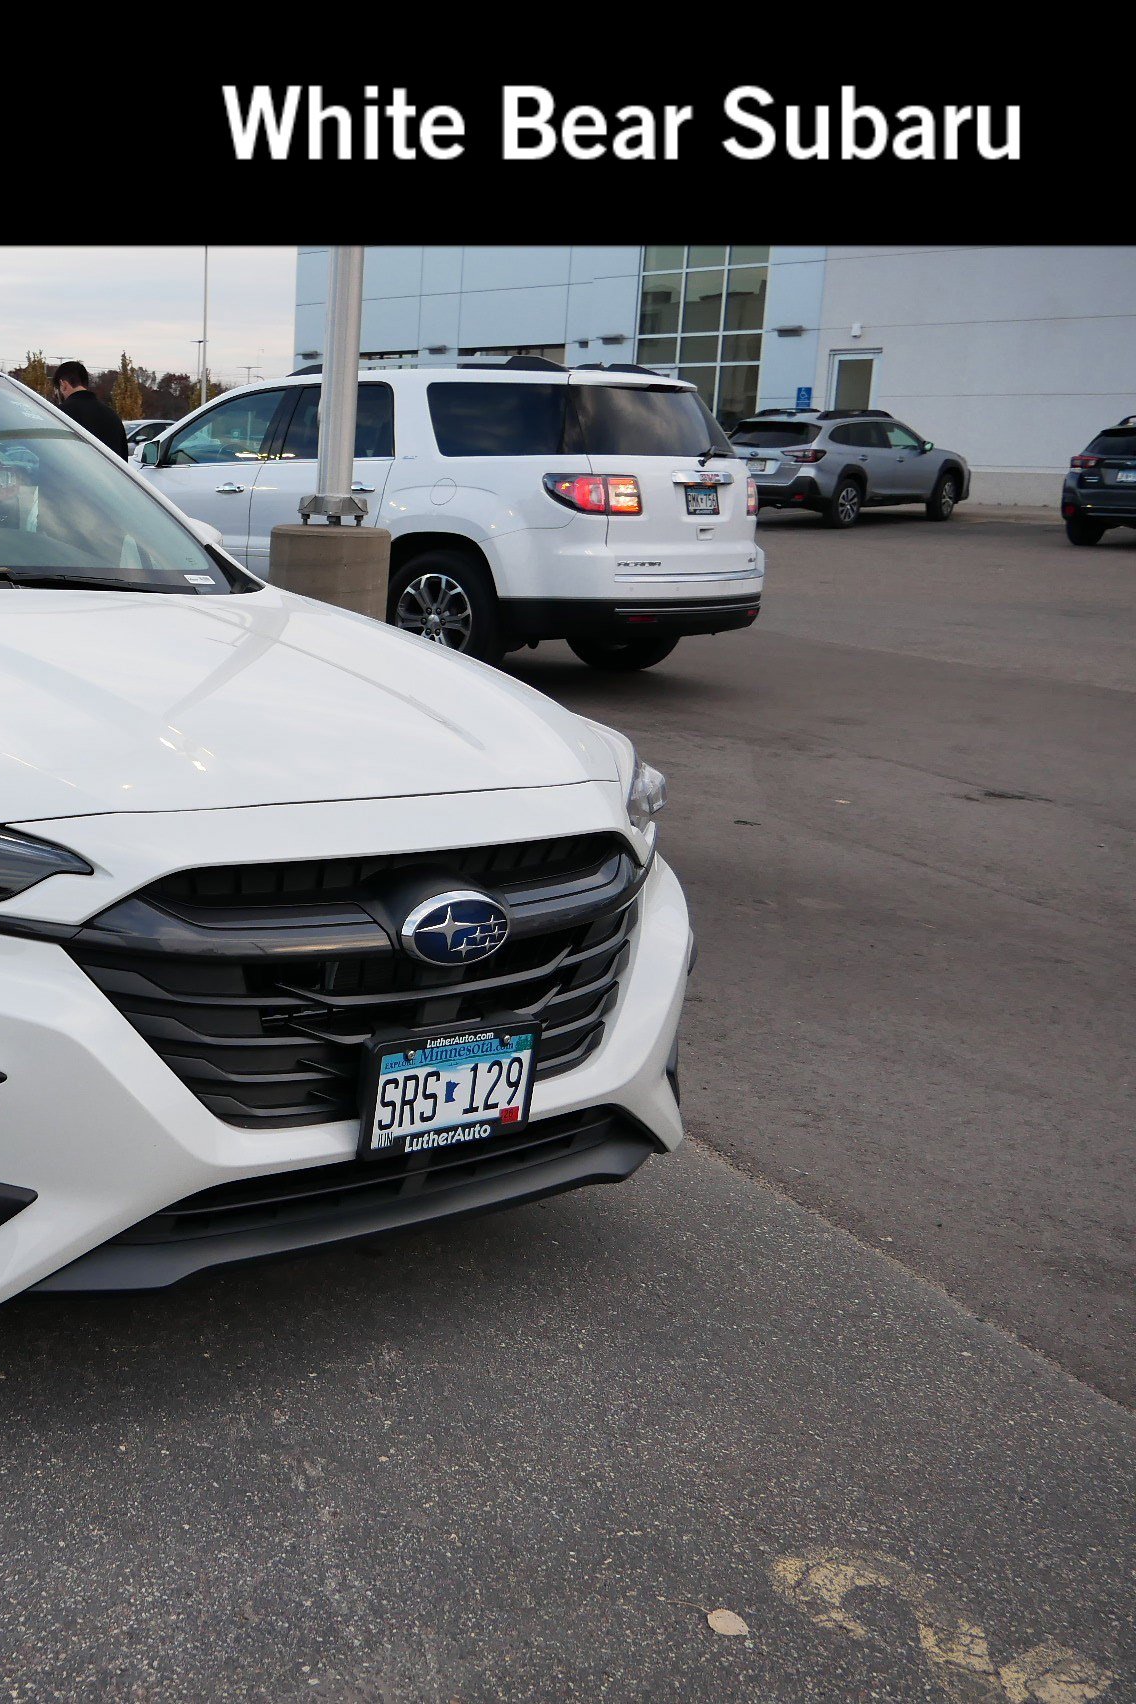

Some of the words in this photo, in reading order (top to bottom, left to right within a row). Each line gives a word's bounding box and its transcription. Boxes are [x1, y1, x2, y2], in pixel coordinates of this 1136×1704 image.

[426, 1032, 494, 1049] LutherAuto.com
[377, 1071, 441, 1131] SRS
[462, 1057, 524, 1115] 129
[405, 1124, 491, 1152] LutherAuto
